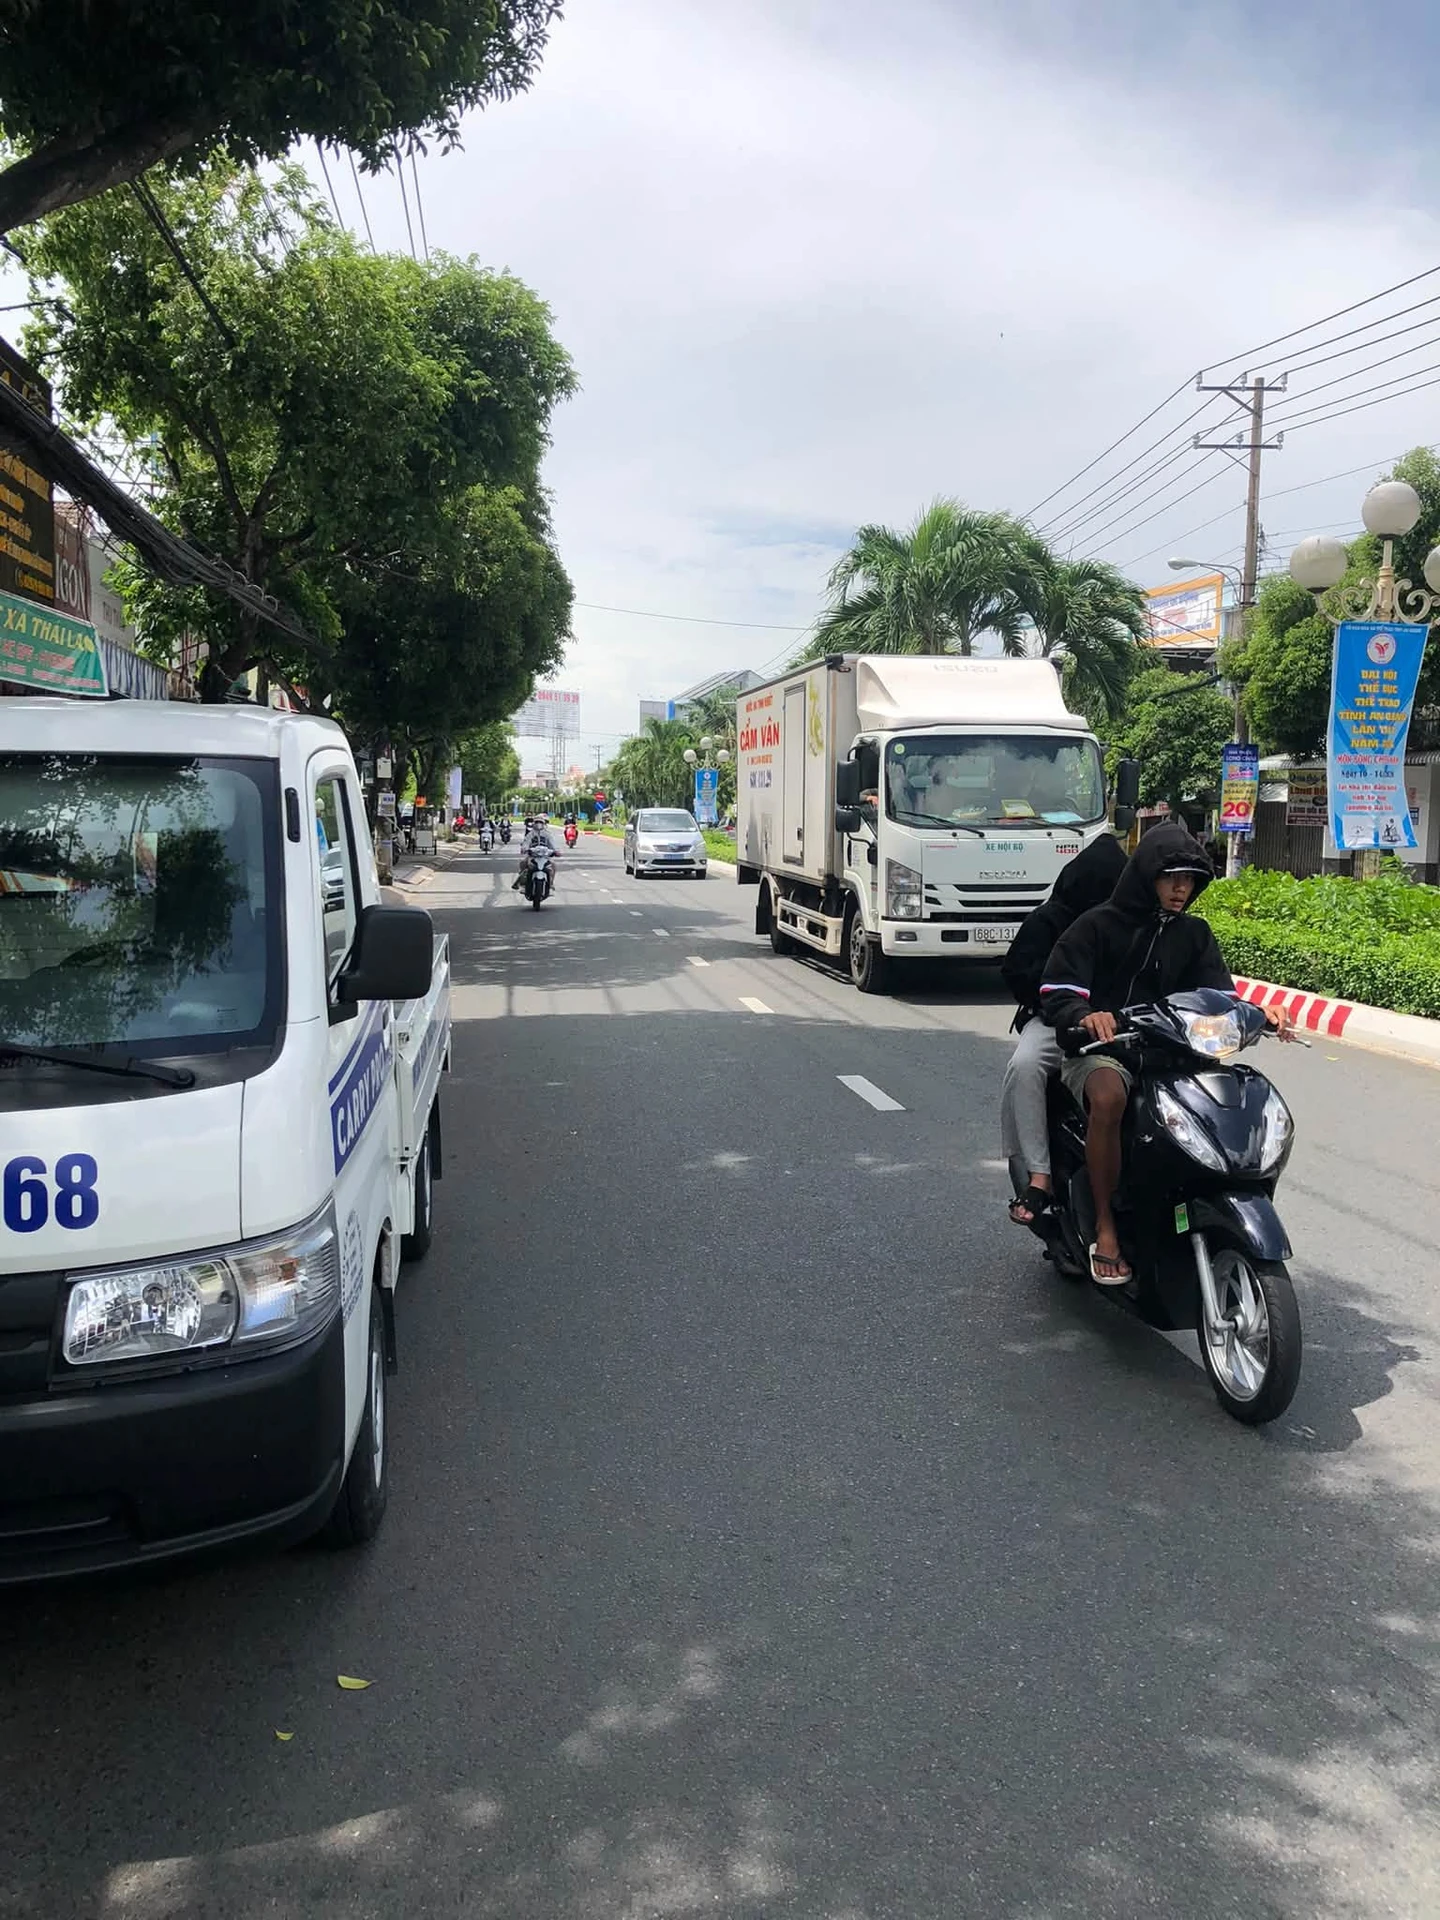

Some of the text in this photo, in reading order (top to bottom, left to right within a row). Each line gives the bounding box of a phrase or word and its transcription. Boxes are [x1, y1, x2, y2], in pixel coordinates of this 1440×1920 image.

[761, 715, 780, 748] VÂN
[985, 841, 1024, 853] XE NỘI BỘ
[977, 928, 1014, 940] 68C-131
[337, 1066, 370, 1156] CARRY
[2, 1153, 99, 1233] 68
